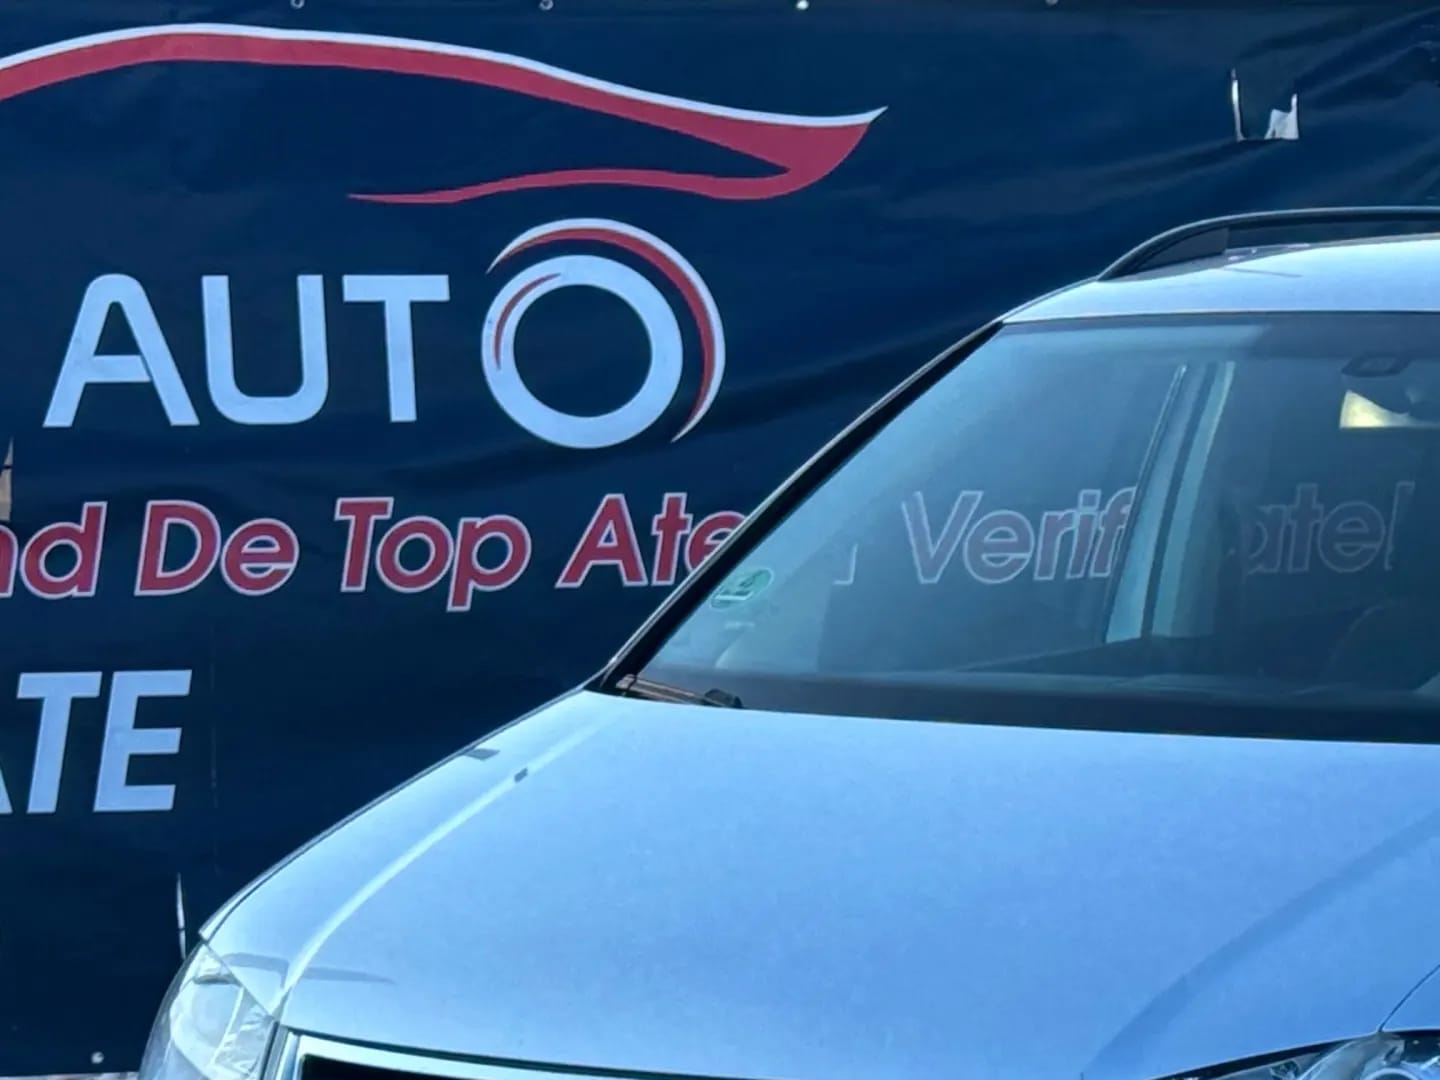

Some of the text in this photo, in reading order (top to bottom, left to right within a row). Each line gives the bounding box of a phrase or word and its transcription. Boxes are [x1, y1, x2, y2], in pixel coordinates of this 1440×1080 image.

[43, 254, 684, 449] AUTO
[0, 501, 108, 599] d
[135, 500, 300, 596] De
[335, 496, 532, 612] Top
[555, 492, 748, 588] Ate
[0, 670, 192, 814] TE
